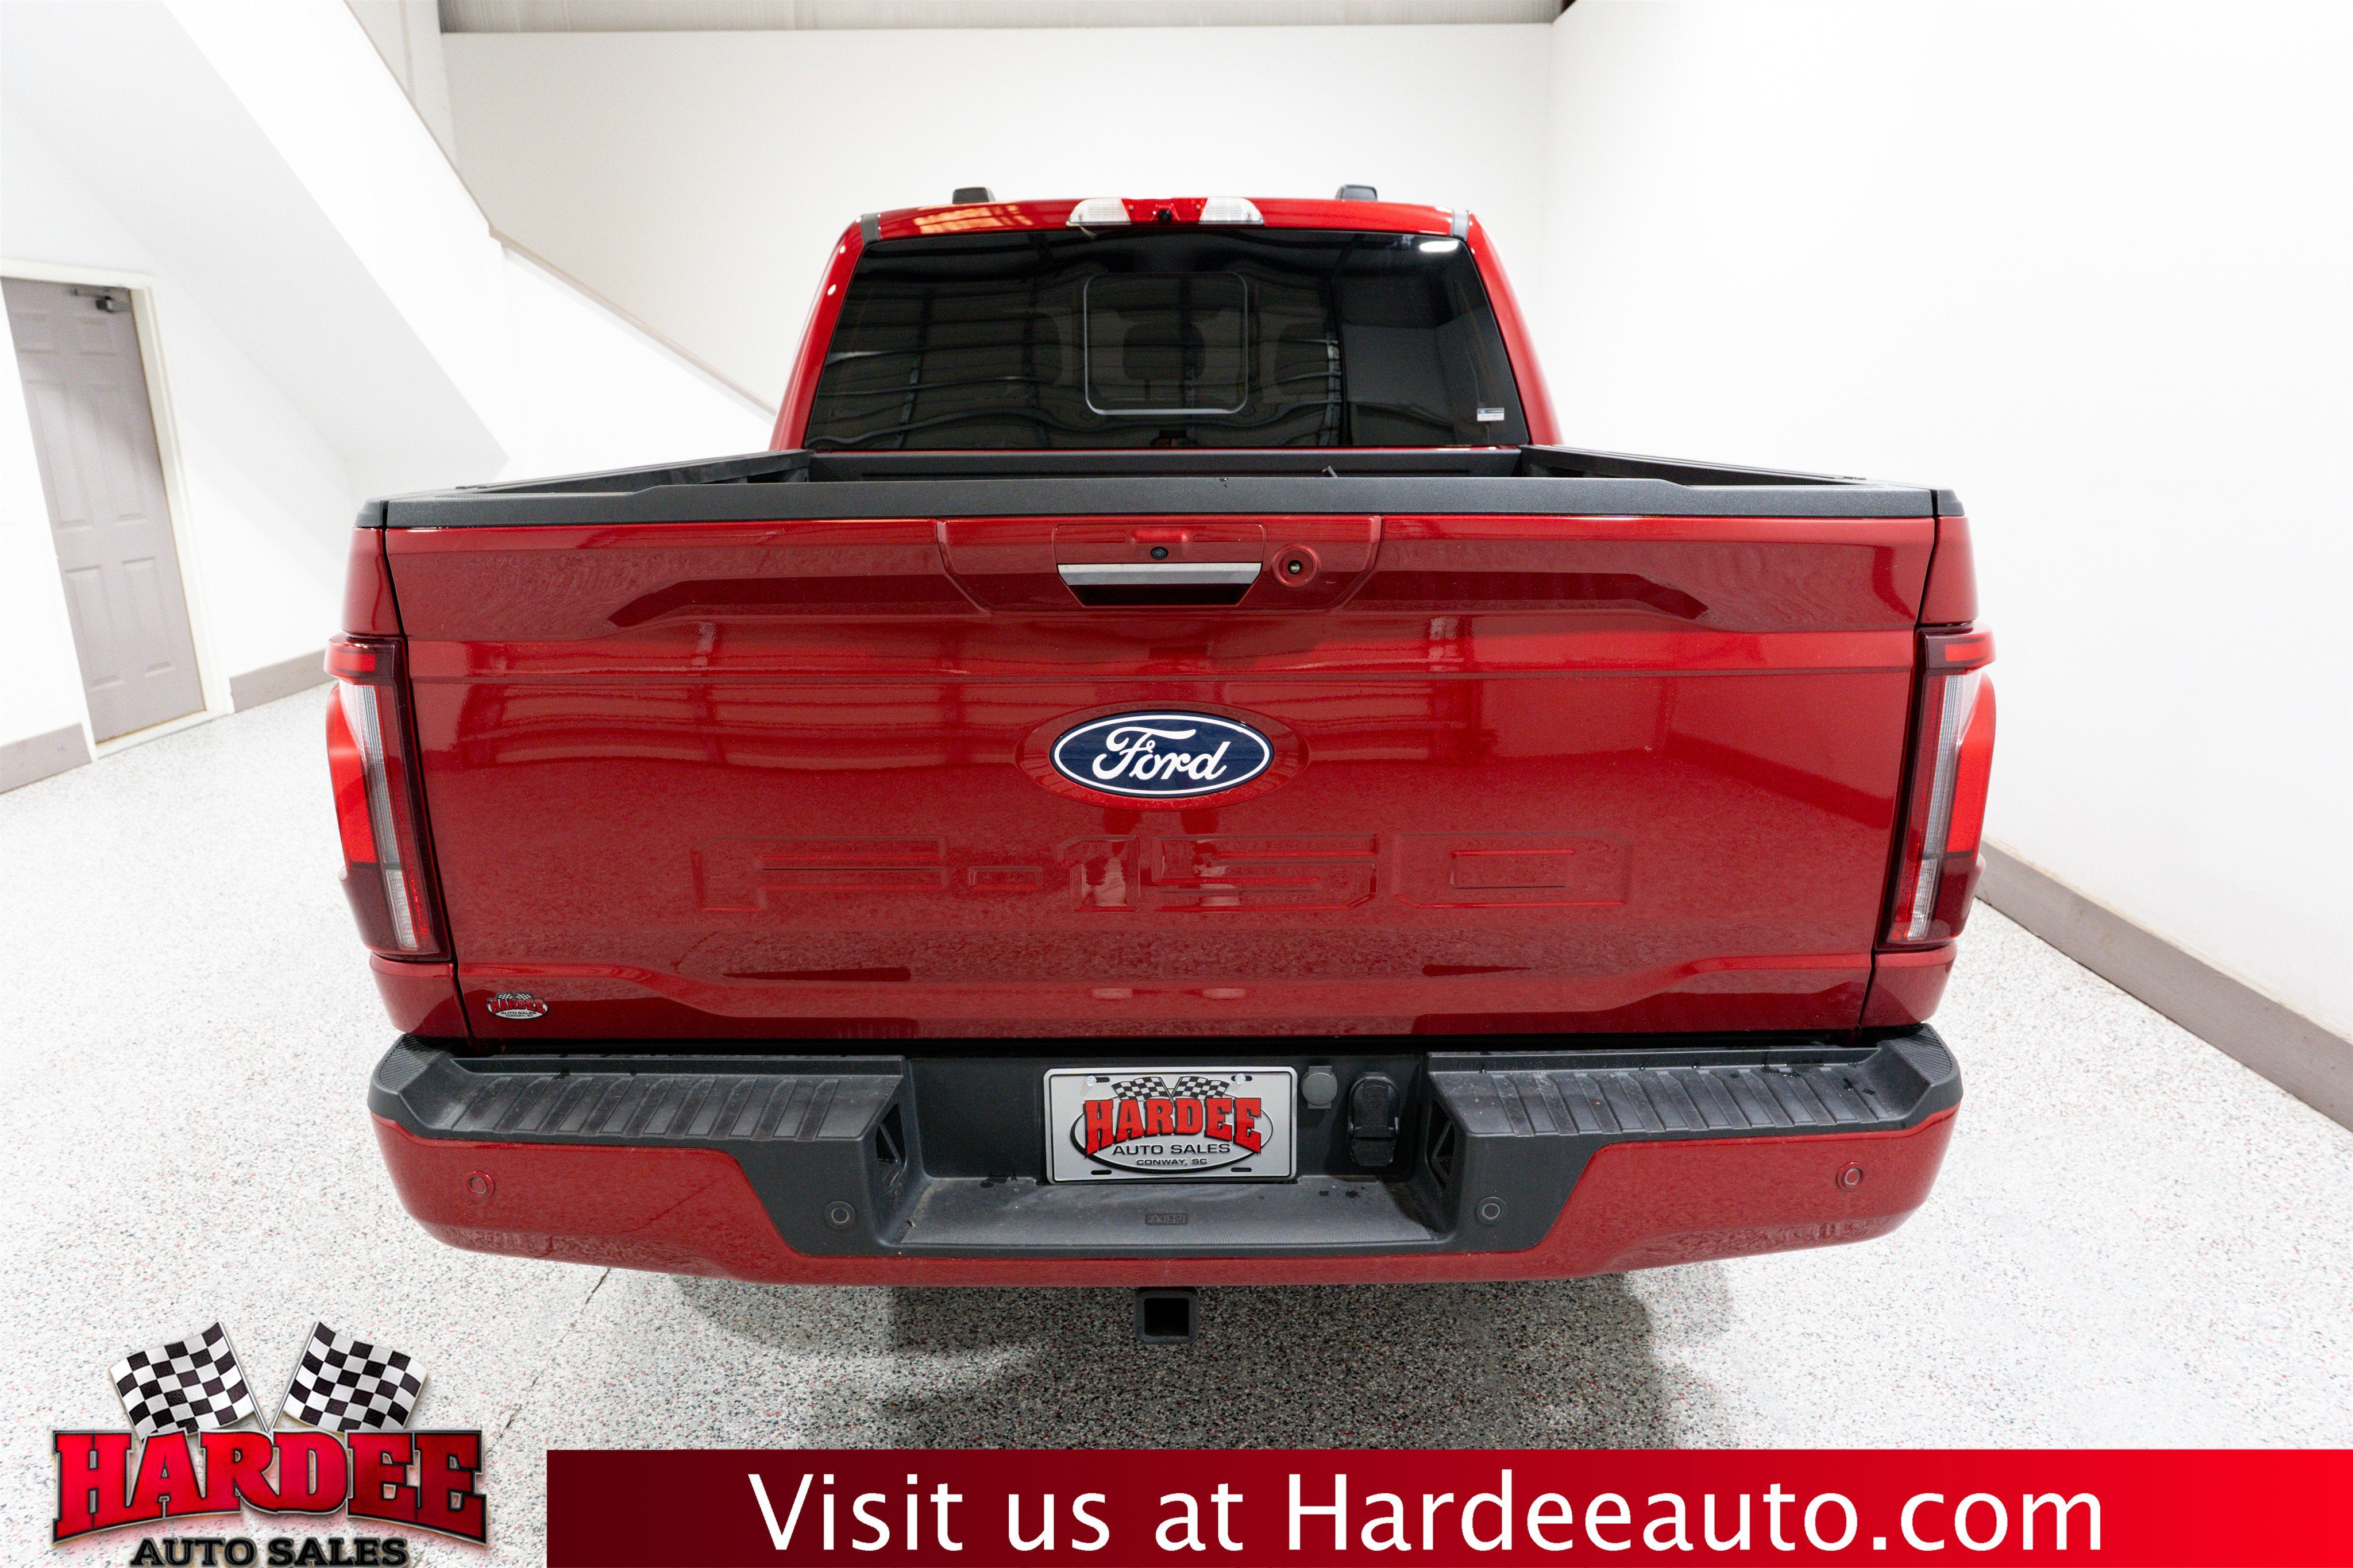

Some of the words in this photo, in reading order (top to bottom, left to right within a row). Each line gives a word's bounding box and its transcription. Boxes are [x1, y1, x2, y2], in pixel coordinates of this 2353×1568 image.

[1092, 727, 1230, 780] Ford
[692, 832, 1632, 913] F-150
[489, 998, 546, 1014] HARDEE
[1083, 1098, 1262, 1156] HARDEE
[1112, 1145, 1164, 1156] AUTO
[1171, 1144, 1230, 1154] SALES
